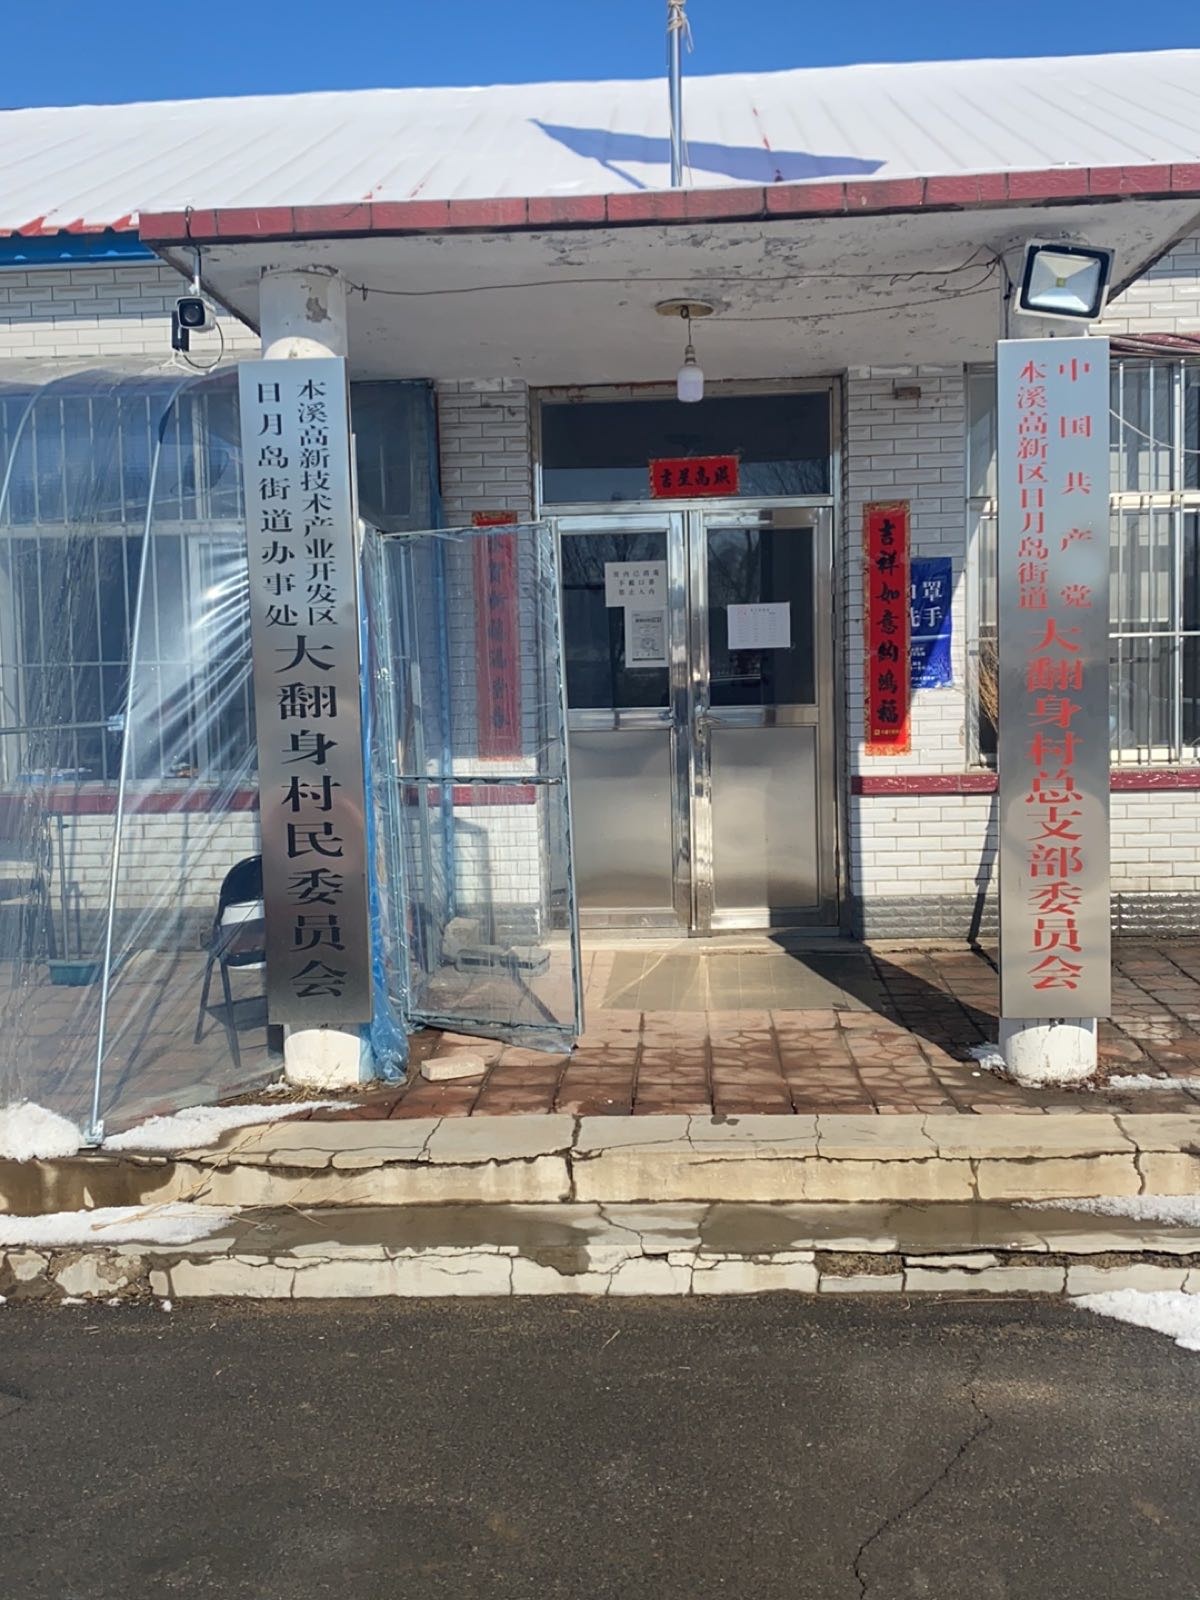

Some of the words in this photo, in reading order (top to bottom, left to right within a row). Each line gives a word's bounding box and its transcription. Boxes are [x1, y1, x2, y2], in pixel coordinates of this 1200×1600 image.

[257, 381, 298, 628] 日月岛街道办事处
[297, 378, 338, 626] 本溪高新技术产业开发区
[1016, 360, 1049, 609] 本溪高新区日月岛街道
[1058, 357, 1093, 609] 中国共产党
[274, 634, 350, 998] 大翻身村民委员会
[1025, 617, 1084, 990] 大翻身村总支部委员会
